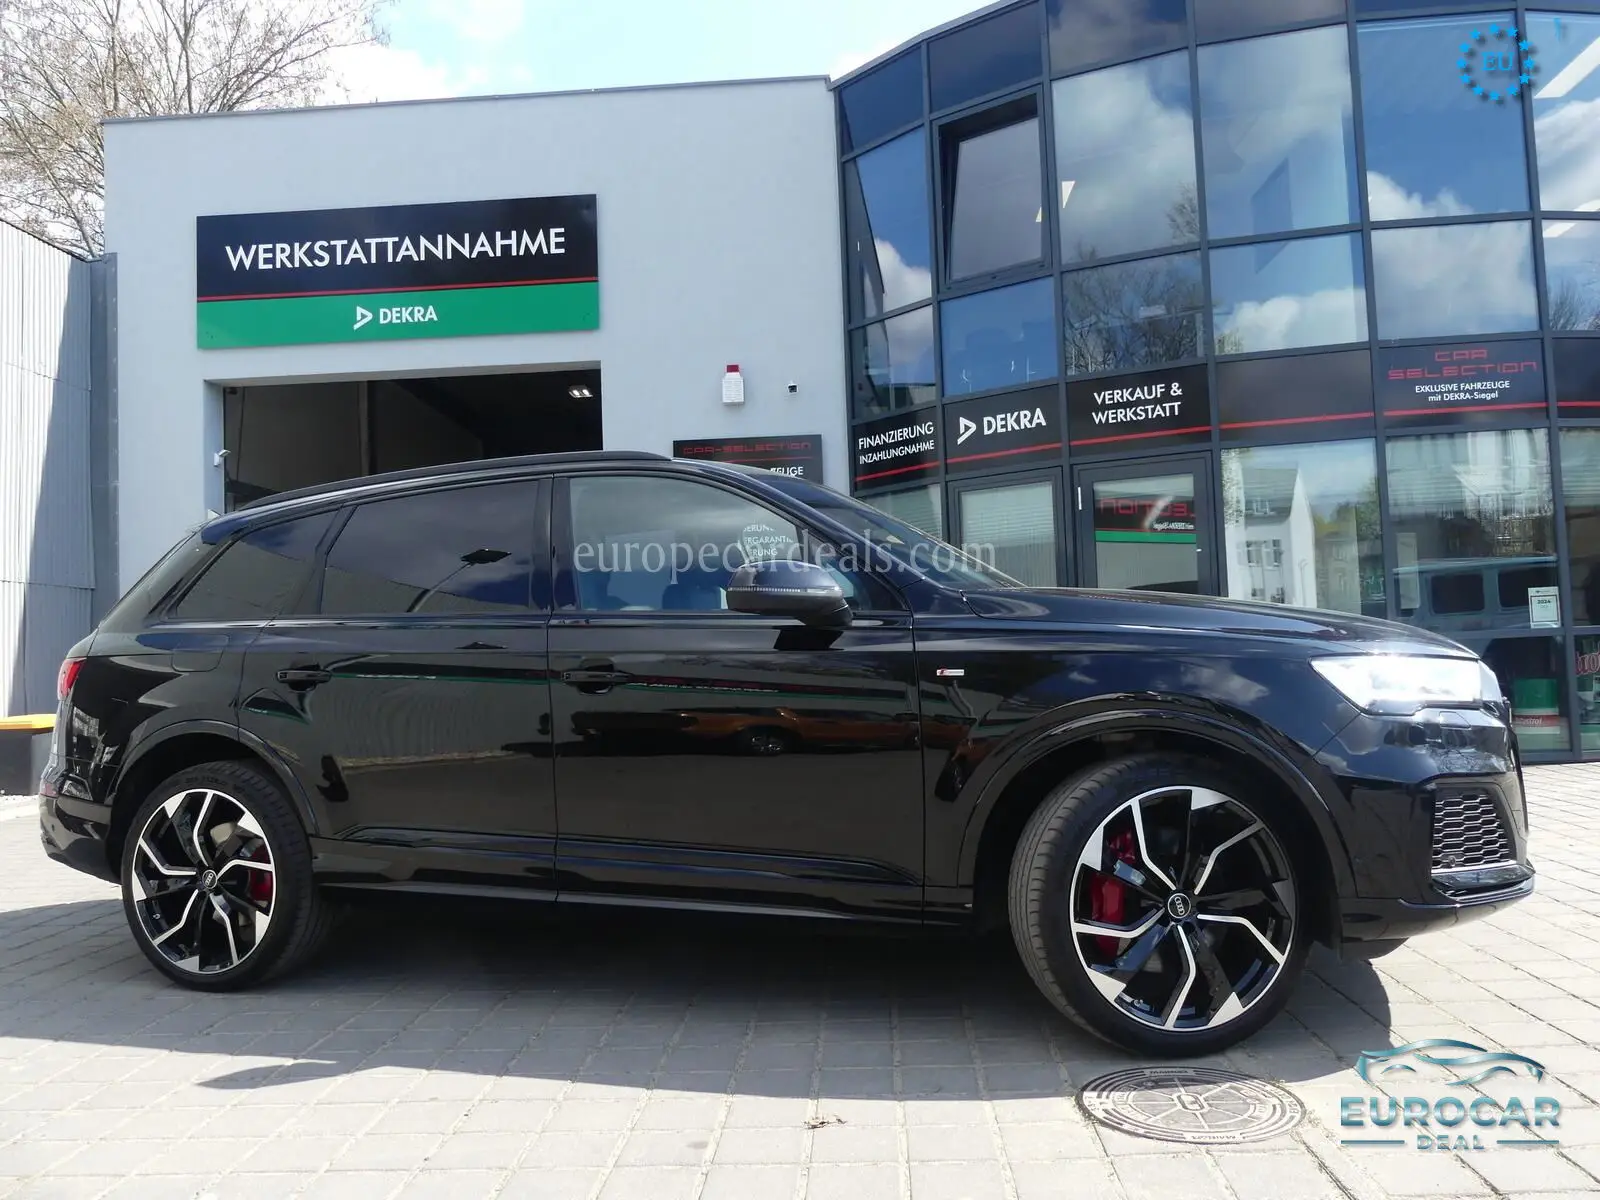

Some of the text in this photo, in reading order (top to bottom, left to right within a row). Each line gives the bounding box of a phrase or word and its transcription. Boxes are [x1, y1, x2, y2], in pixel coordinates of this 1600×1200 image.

[225, 227, 566, 271] WERKSTATTANNAHME
[379, 305, 438, 325] DEKRA
[1093, 382, 1183, 406] VERKAUF &
[1415, 380, 1511, 394] EXKLUSIVE FAHRZEUGE
[1428, 391, 1499, 402] mit DEKRA-Siegel
[983, 407, 1047, 436] DEKRA
[1091, 402, 1182, 425] WERKSTATT
[858, 421, 934, 450] FINANZIERUNG
[858, 439, 935, 465] INZAHLUNGNAHME
